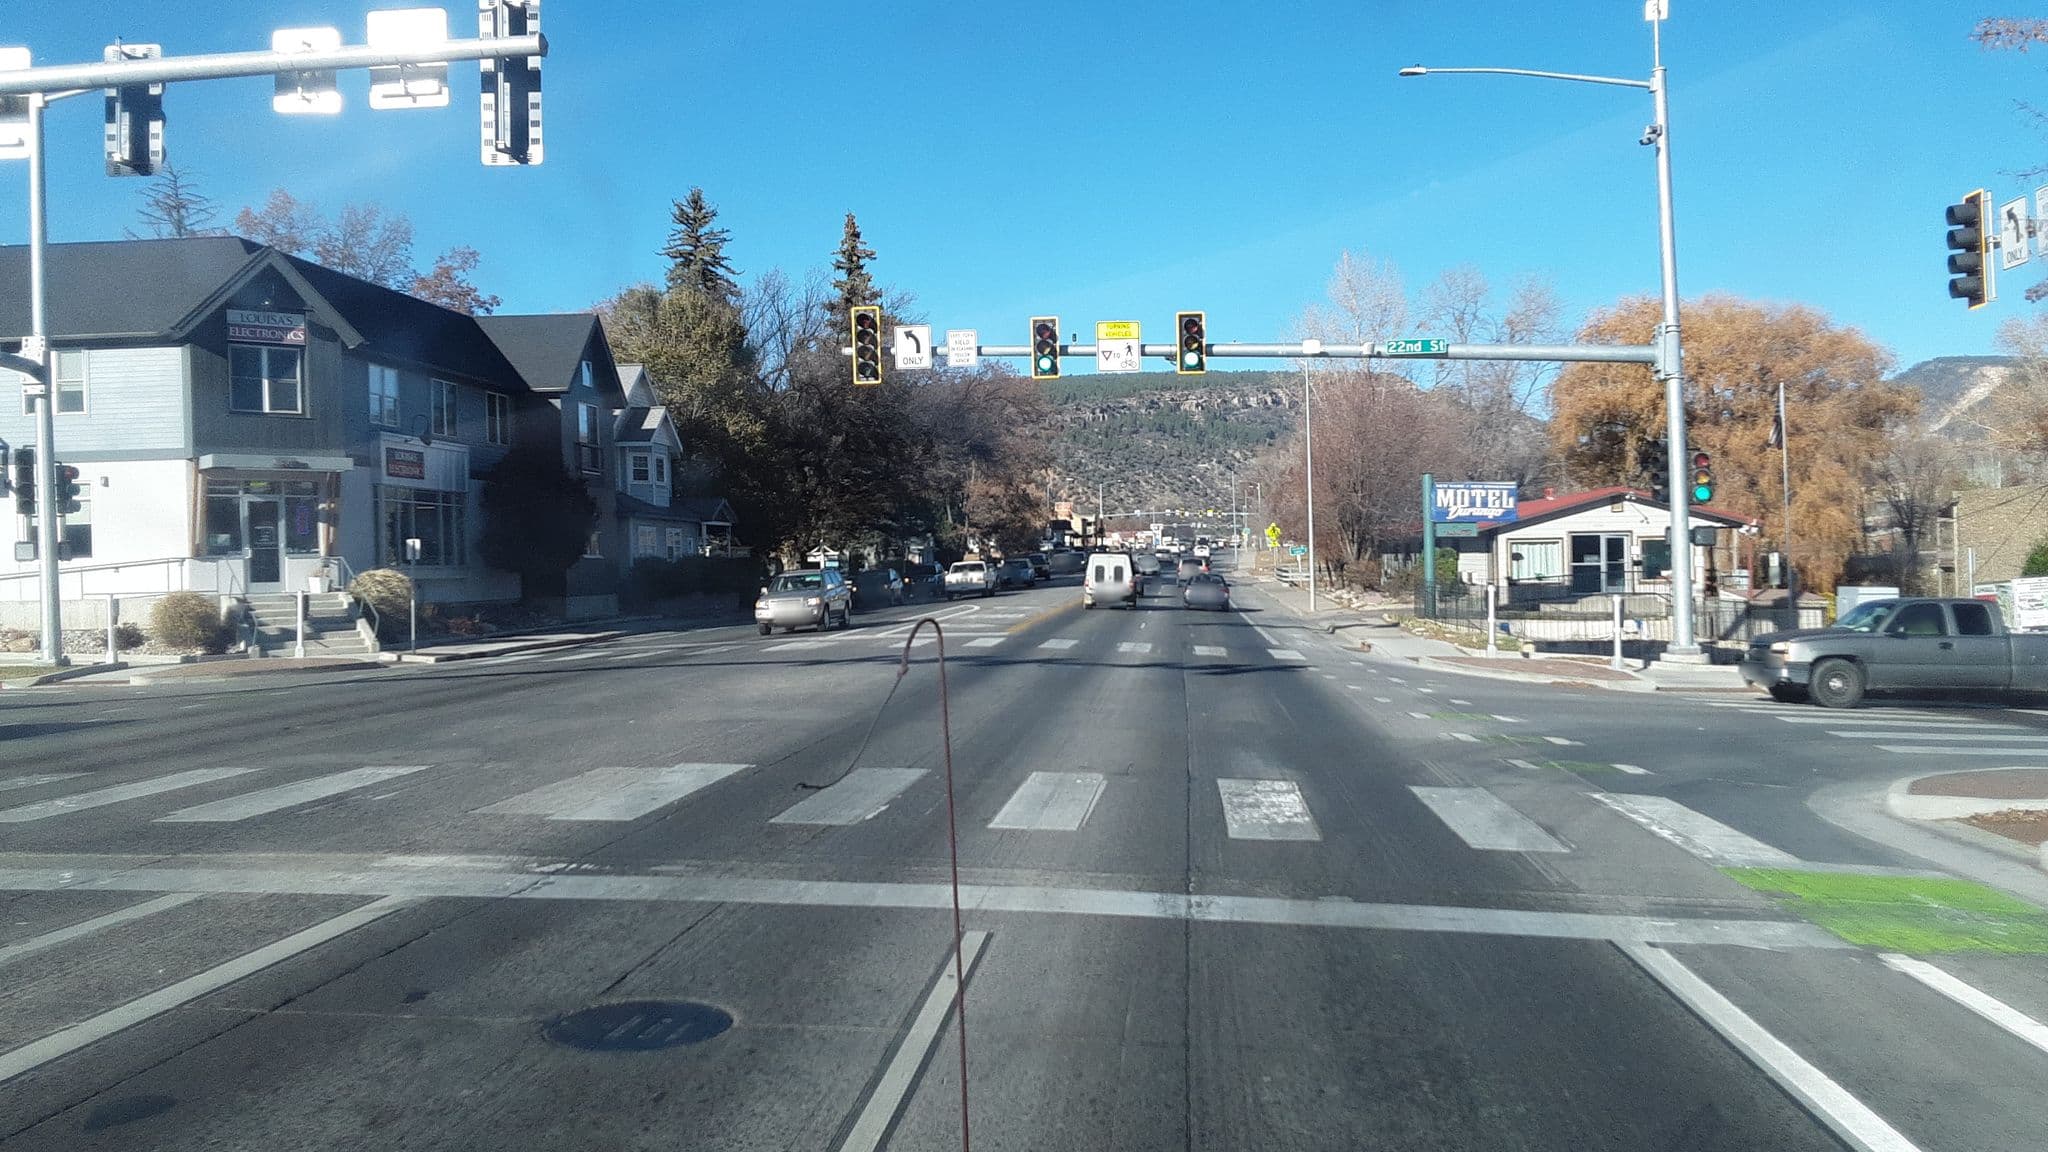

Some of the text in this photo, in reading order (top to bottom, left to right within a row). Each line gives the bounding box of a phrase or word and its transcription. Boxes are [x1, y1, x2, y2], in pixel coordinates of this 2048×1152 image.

[2006, 246, 2024, 264] ONLY
[229, 326, 305, 340] ELECTRONICS
[1388, 340, 1445, 353] 22nd St
[902, 356, 924, 365] ONLY
[1436, 488, 1515, 508] MOTEL
[1446, 506, 1507, 520] Durango
